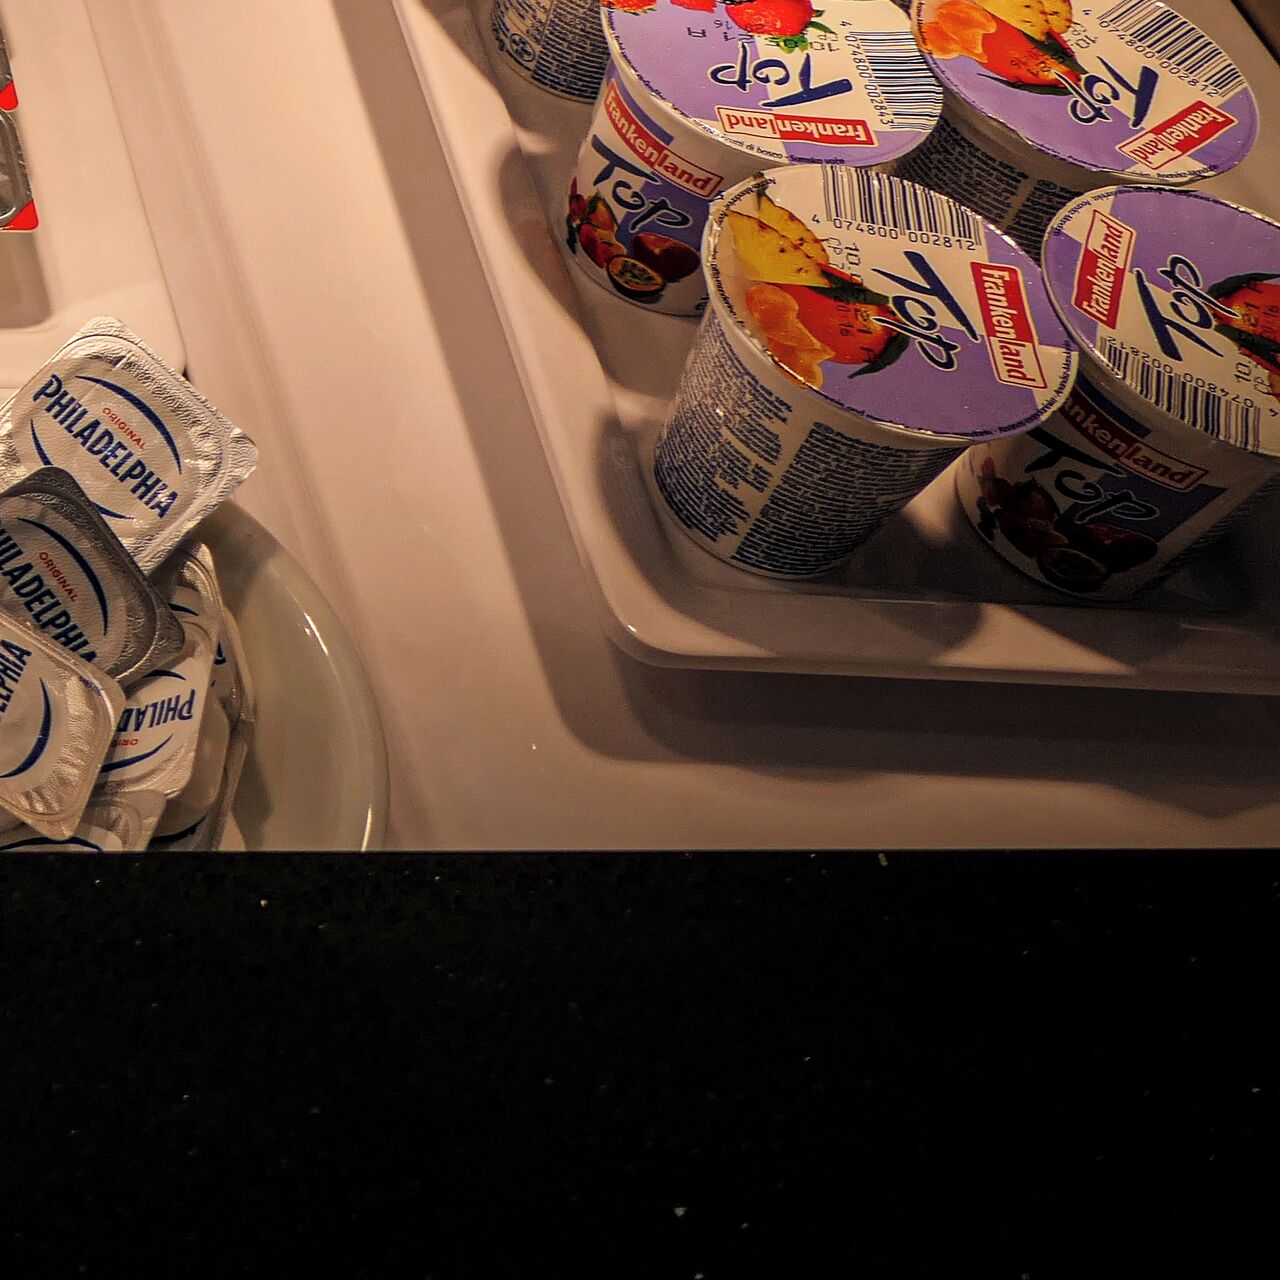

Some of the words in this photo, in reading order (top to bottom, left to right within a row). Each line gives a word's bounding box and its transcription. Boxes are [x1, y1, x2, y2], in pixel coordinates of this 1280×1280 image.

[710, 44, 853, 108] Top
[845, 35, 872, 78] 074800
[864, 84, 894, 125] 002843
[1054, 56, 1159, 128] Top
[1099, 20, 1155, 59] 074800
[1160, 61, 1220, 97] 002812
[605, 95, 712, 192] Frankenland
[727, 113, 866, 140] Frankenland
[1130, 107, 1227, 165] Frankenland
[591, 134, 692, 233] Top
[812, 214, 820, 224] 4
[833, 218, 898, 240] 074800
[907, 230, 975, 251] 002812
[1081, 218, 1124, 322] Frankenland
[871, 251, 980, 371] Top
[980, 267, 1037, 383] Frankenland
[1134, 254, 1240, 361] Top
[1108, 336, 1173, 373] 002812
[1183, 372, 1253, 408] 074800
[33, 373, 178, 519] PHILADELPHIA
[102, 407, 146, 450] ORIGINAL
[1025, 428, 1159, 524] Top
[39, 552, 78, 602] ORIGINAL
[115, 689, 196, 733] PHILAD
